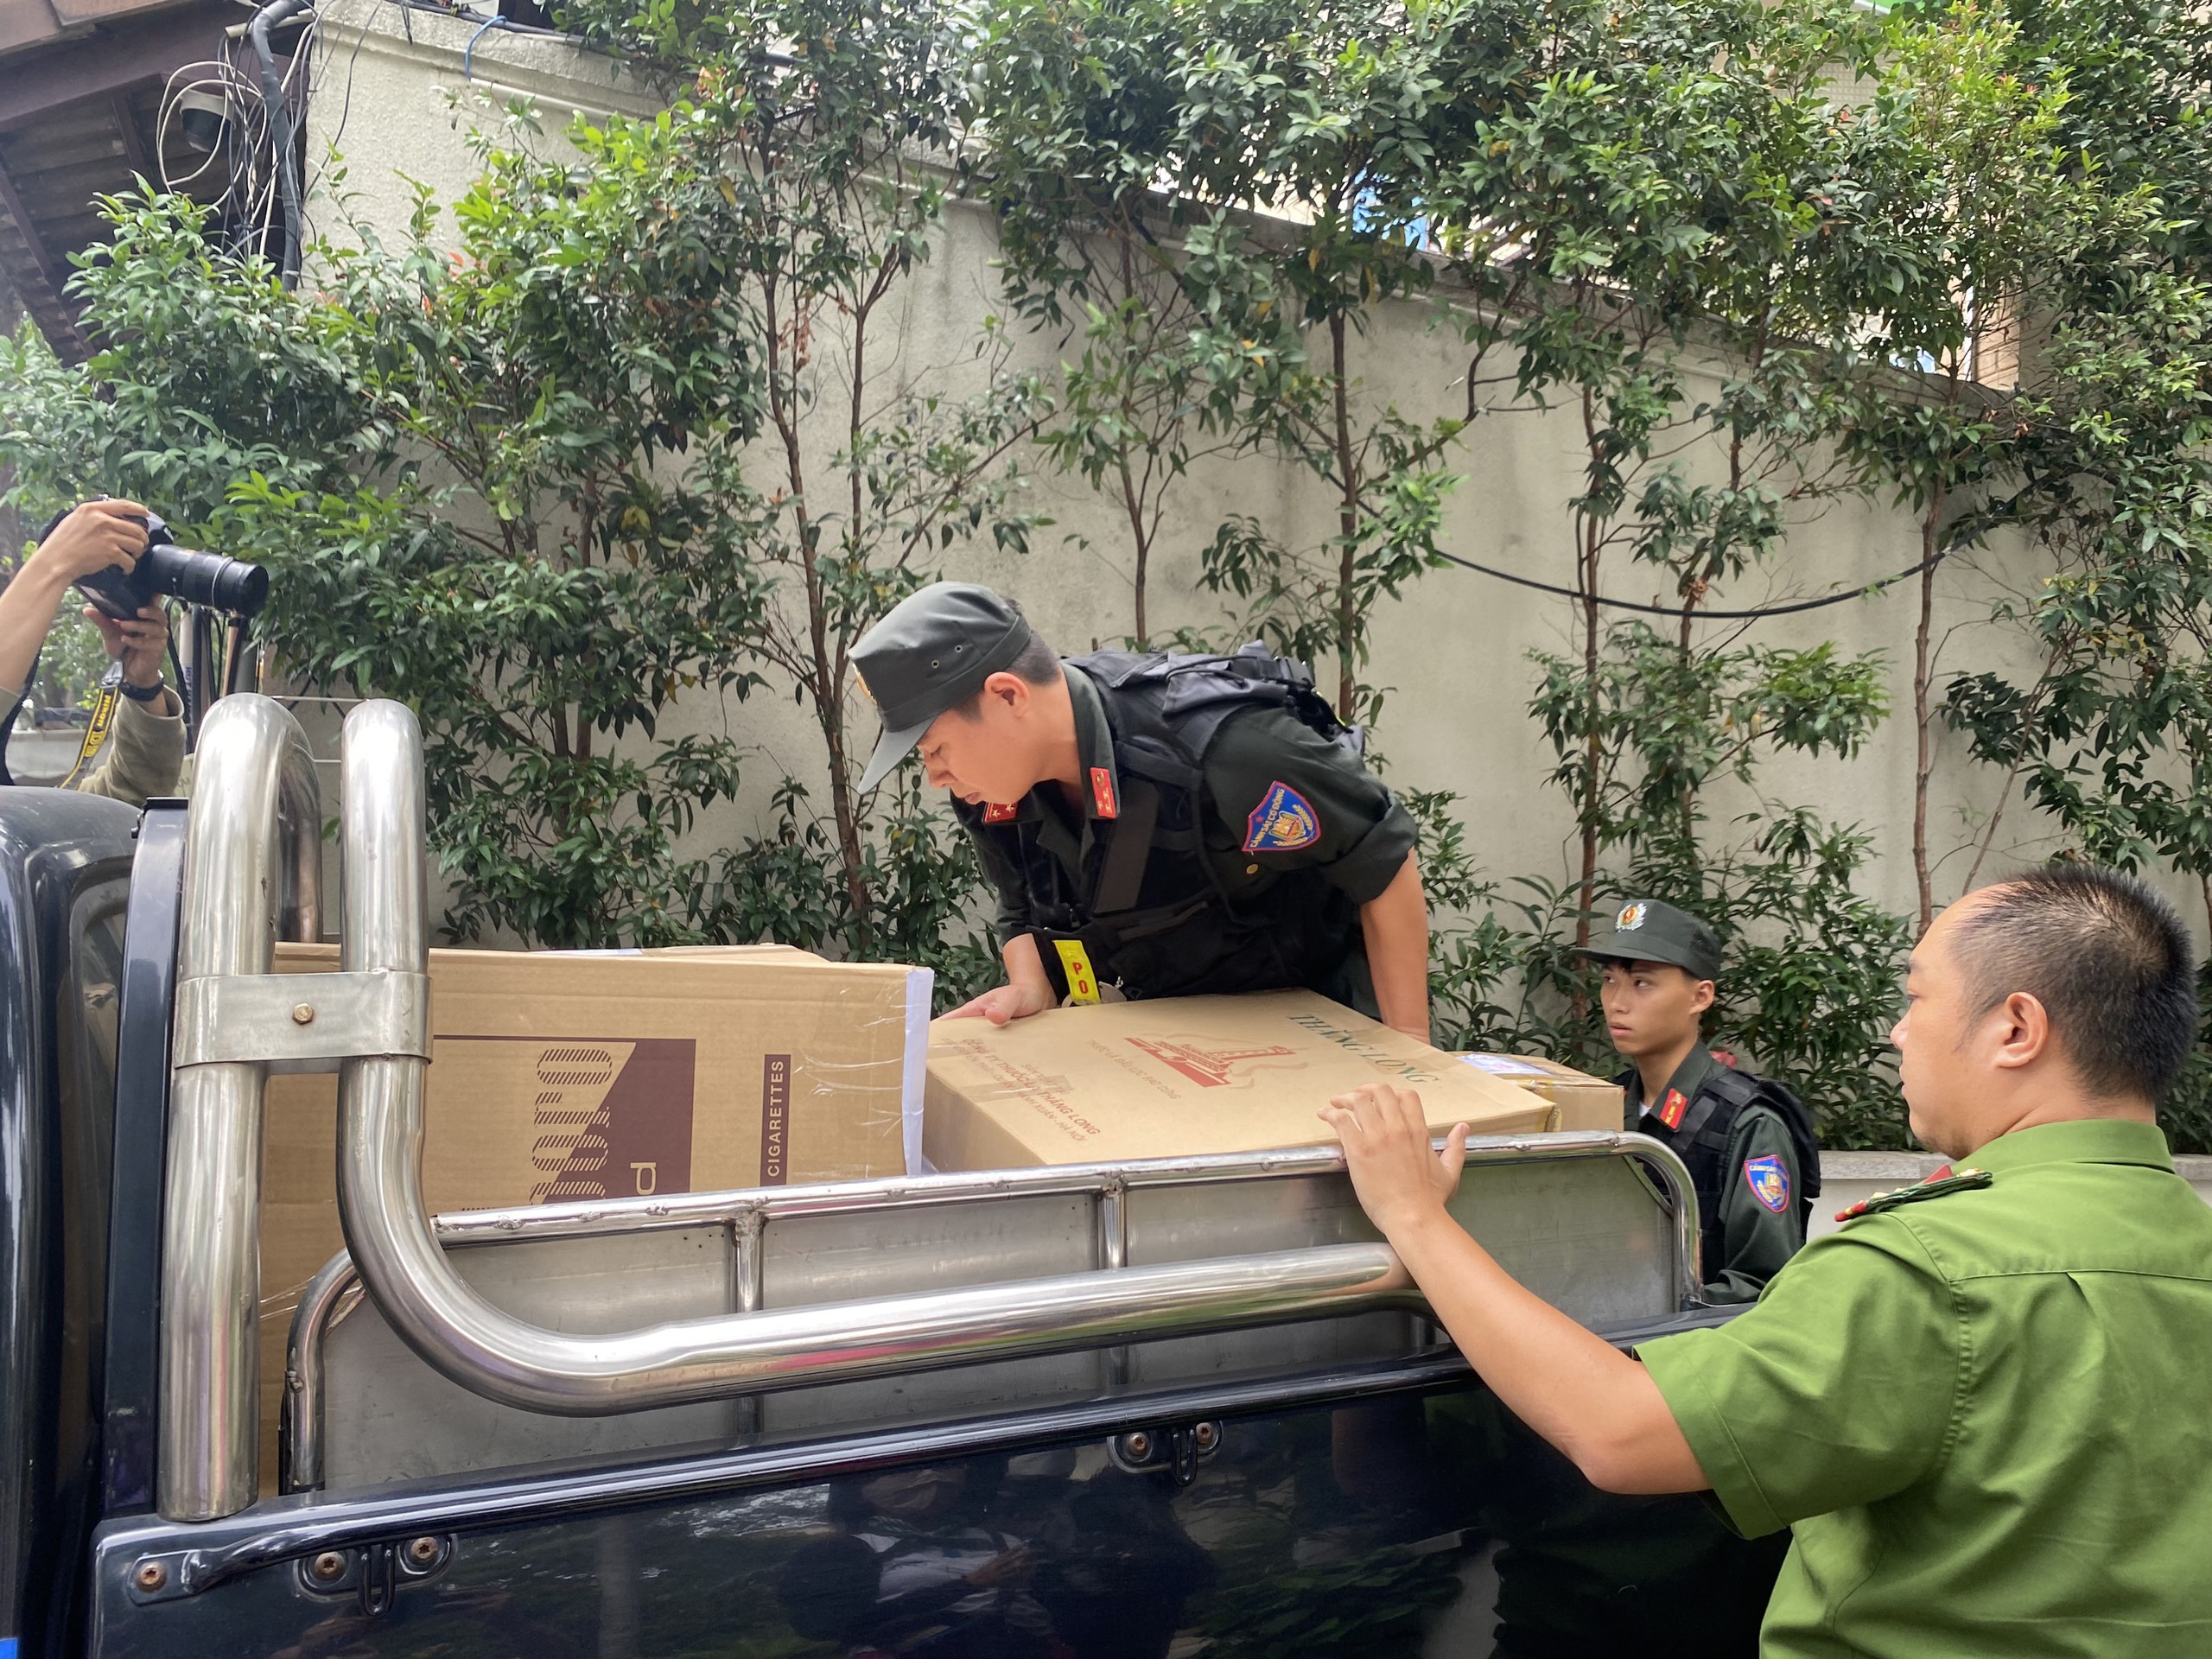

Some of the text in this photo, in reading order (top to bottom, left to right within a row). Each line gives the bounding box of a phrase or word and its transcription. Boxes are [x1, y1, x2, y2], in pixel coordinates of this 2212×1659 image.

[1249, 830, 1266, 848] CẢNH
[1261, 820, 1273, 832] SÁT
[1287, 1014, 1373, 1051] THĂNG
[1360, 1053, 1440, 1083] LONG
[767, 1061, 784, 1177] CIGARETTES
[996, 1062, 1030, 1082] THUỐC
[1037, 1090, 1073, 1114] THĂNG
[1067, 1114, 1100, 1135] LONG
